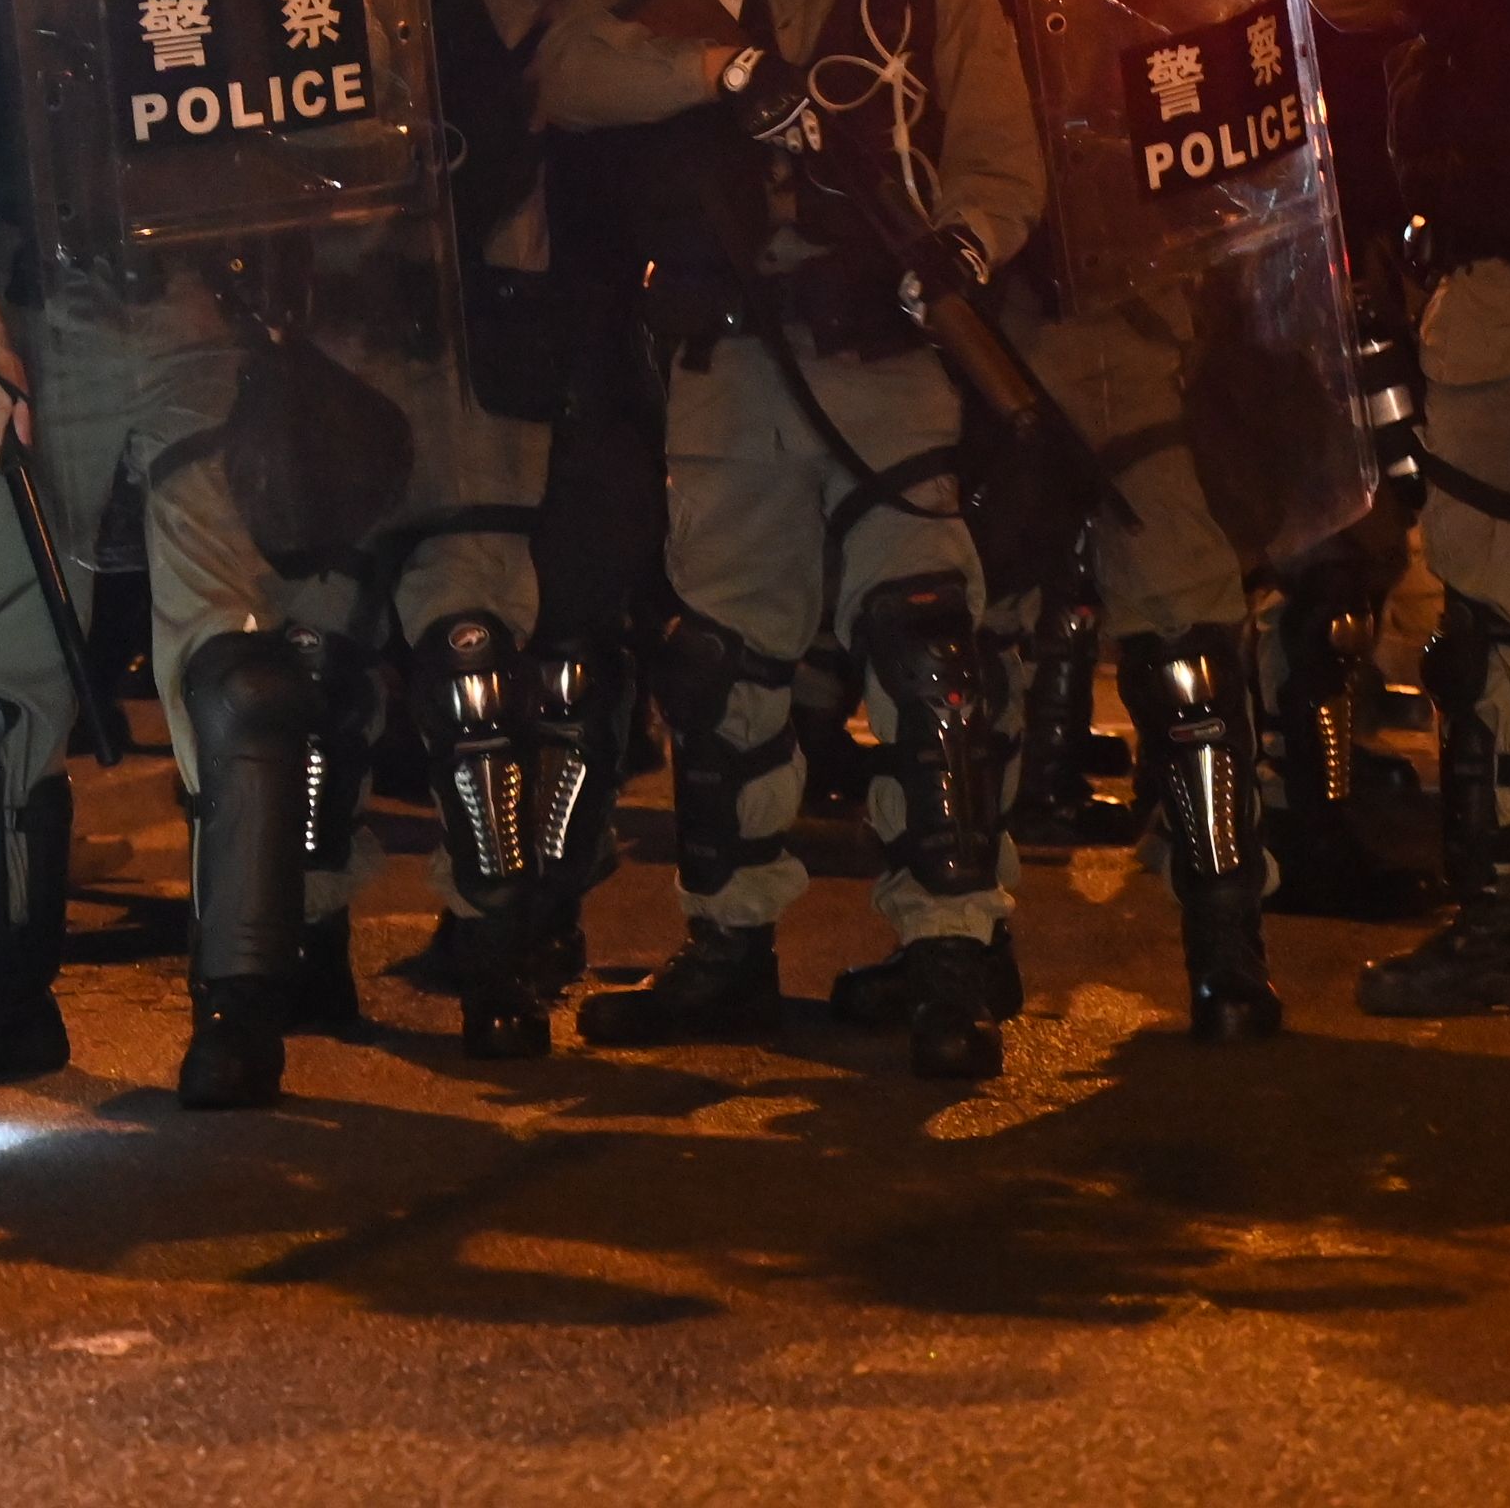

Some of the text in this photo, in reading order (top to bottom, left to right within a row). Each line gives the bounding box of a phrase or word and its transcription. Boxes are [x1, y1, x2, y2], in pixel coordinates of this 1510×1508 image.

[131, 63, 367, 142] POLICE
[1146, 14, 1283, 122] 警察
[1144, 93, 1303, 191] POLICE
